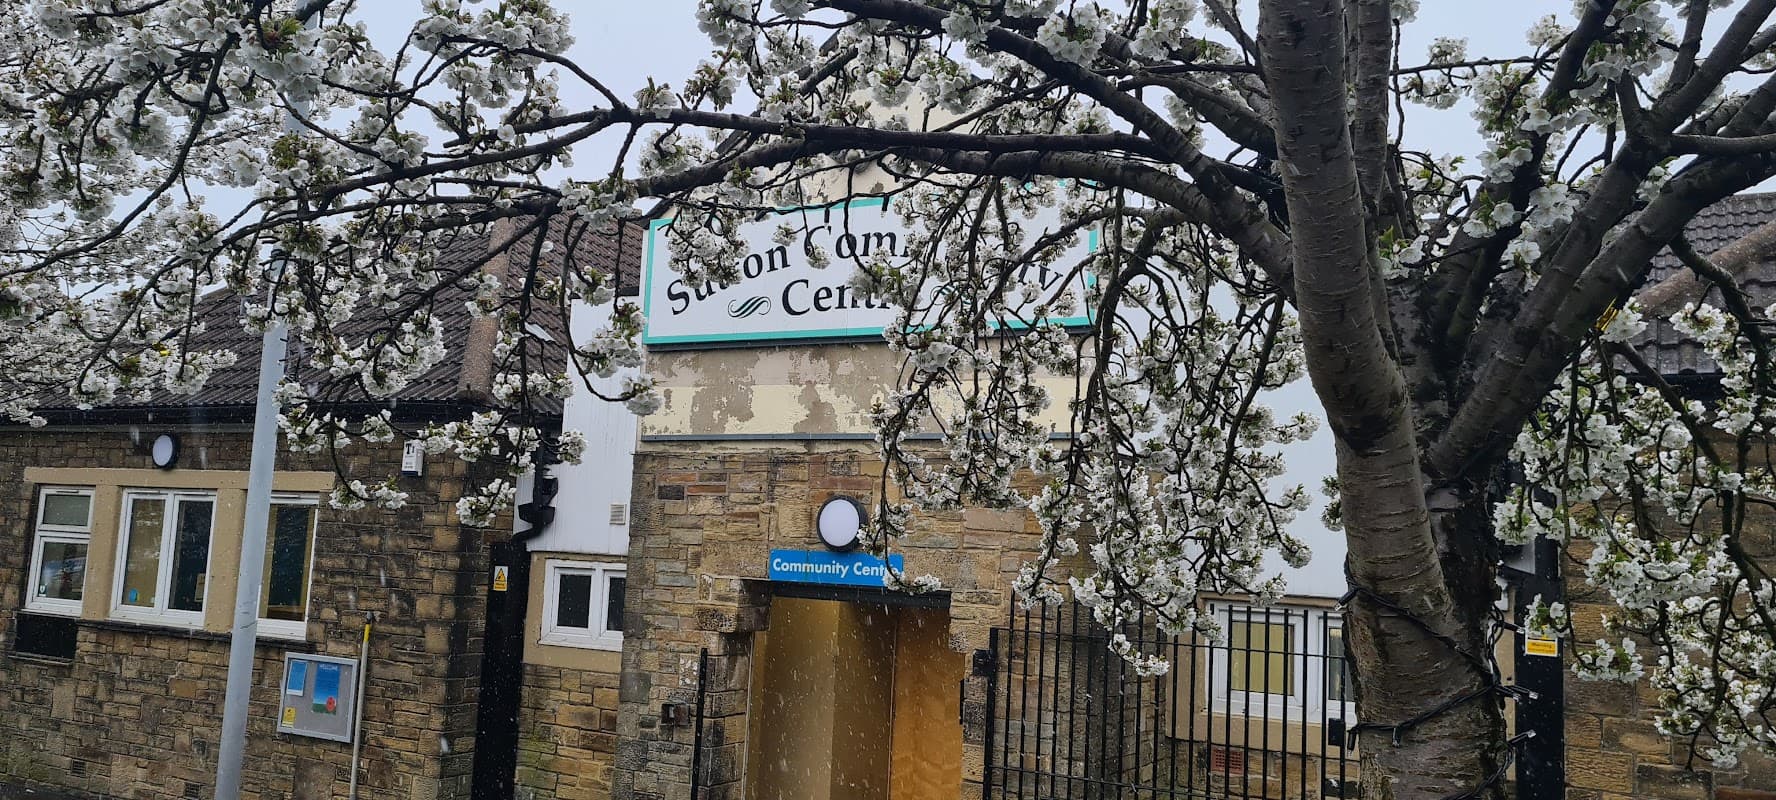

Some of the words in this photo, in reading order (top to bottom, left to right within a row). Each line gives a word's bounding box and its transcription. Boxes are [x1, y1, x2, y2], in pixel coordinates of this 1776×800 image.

[667, 244, 791, 316] Suon
[803, 225, 1064, 292] Comty
[781, 278, 891, 316] Cen
[772, 558, 849, 578] Community
[852, 561, 899, 578] Cent
